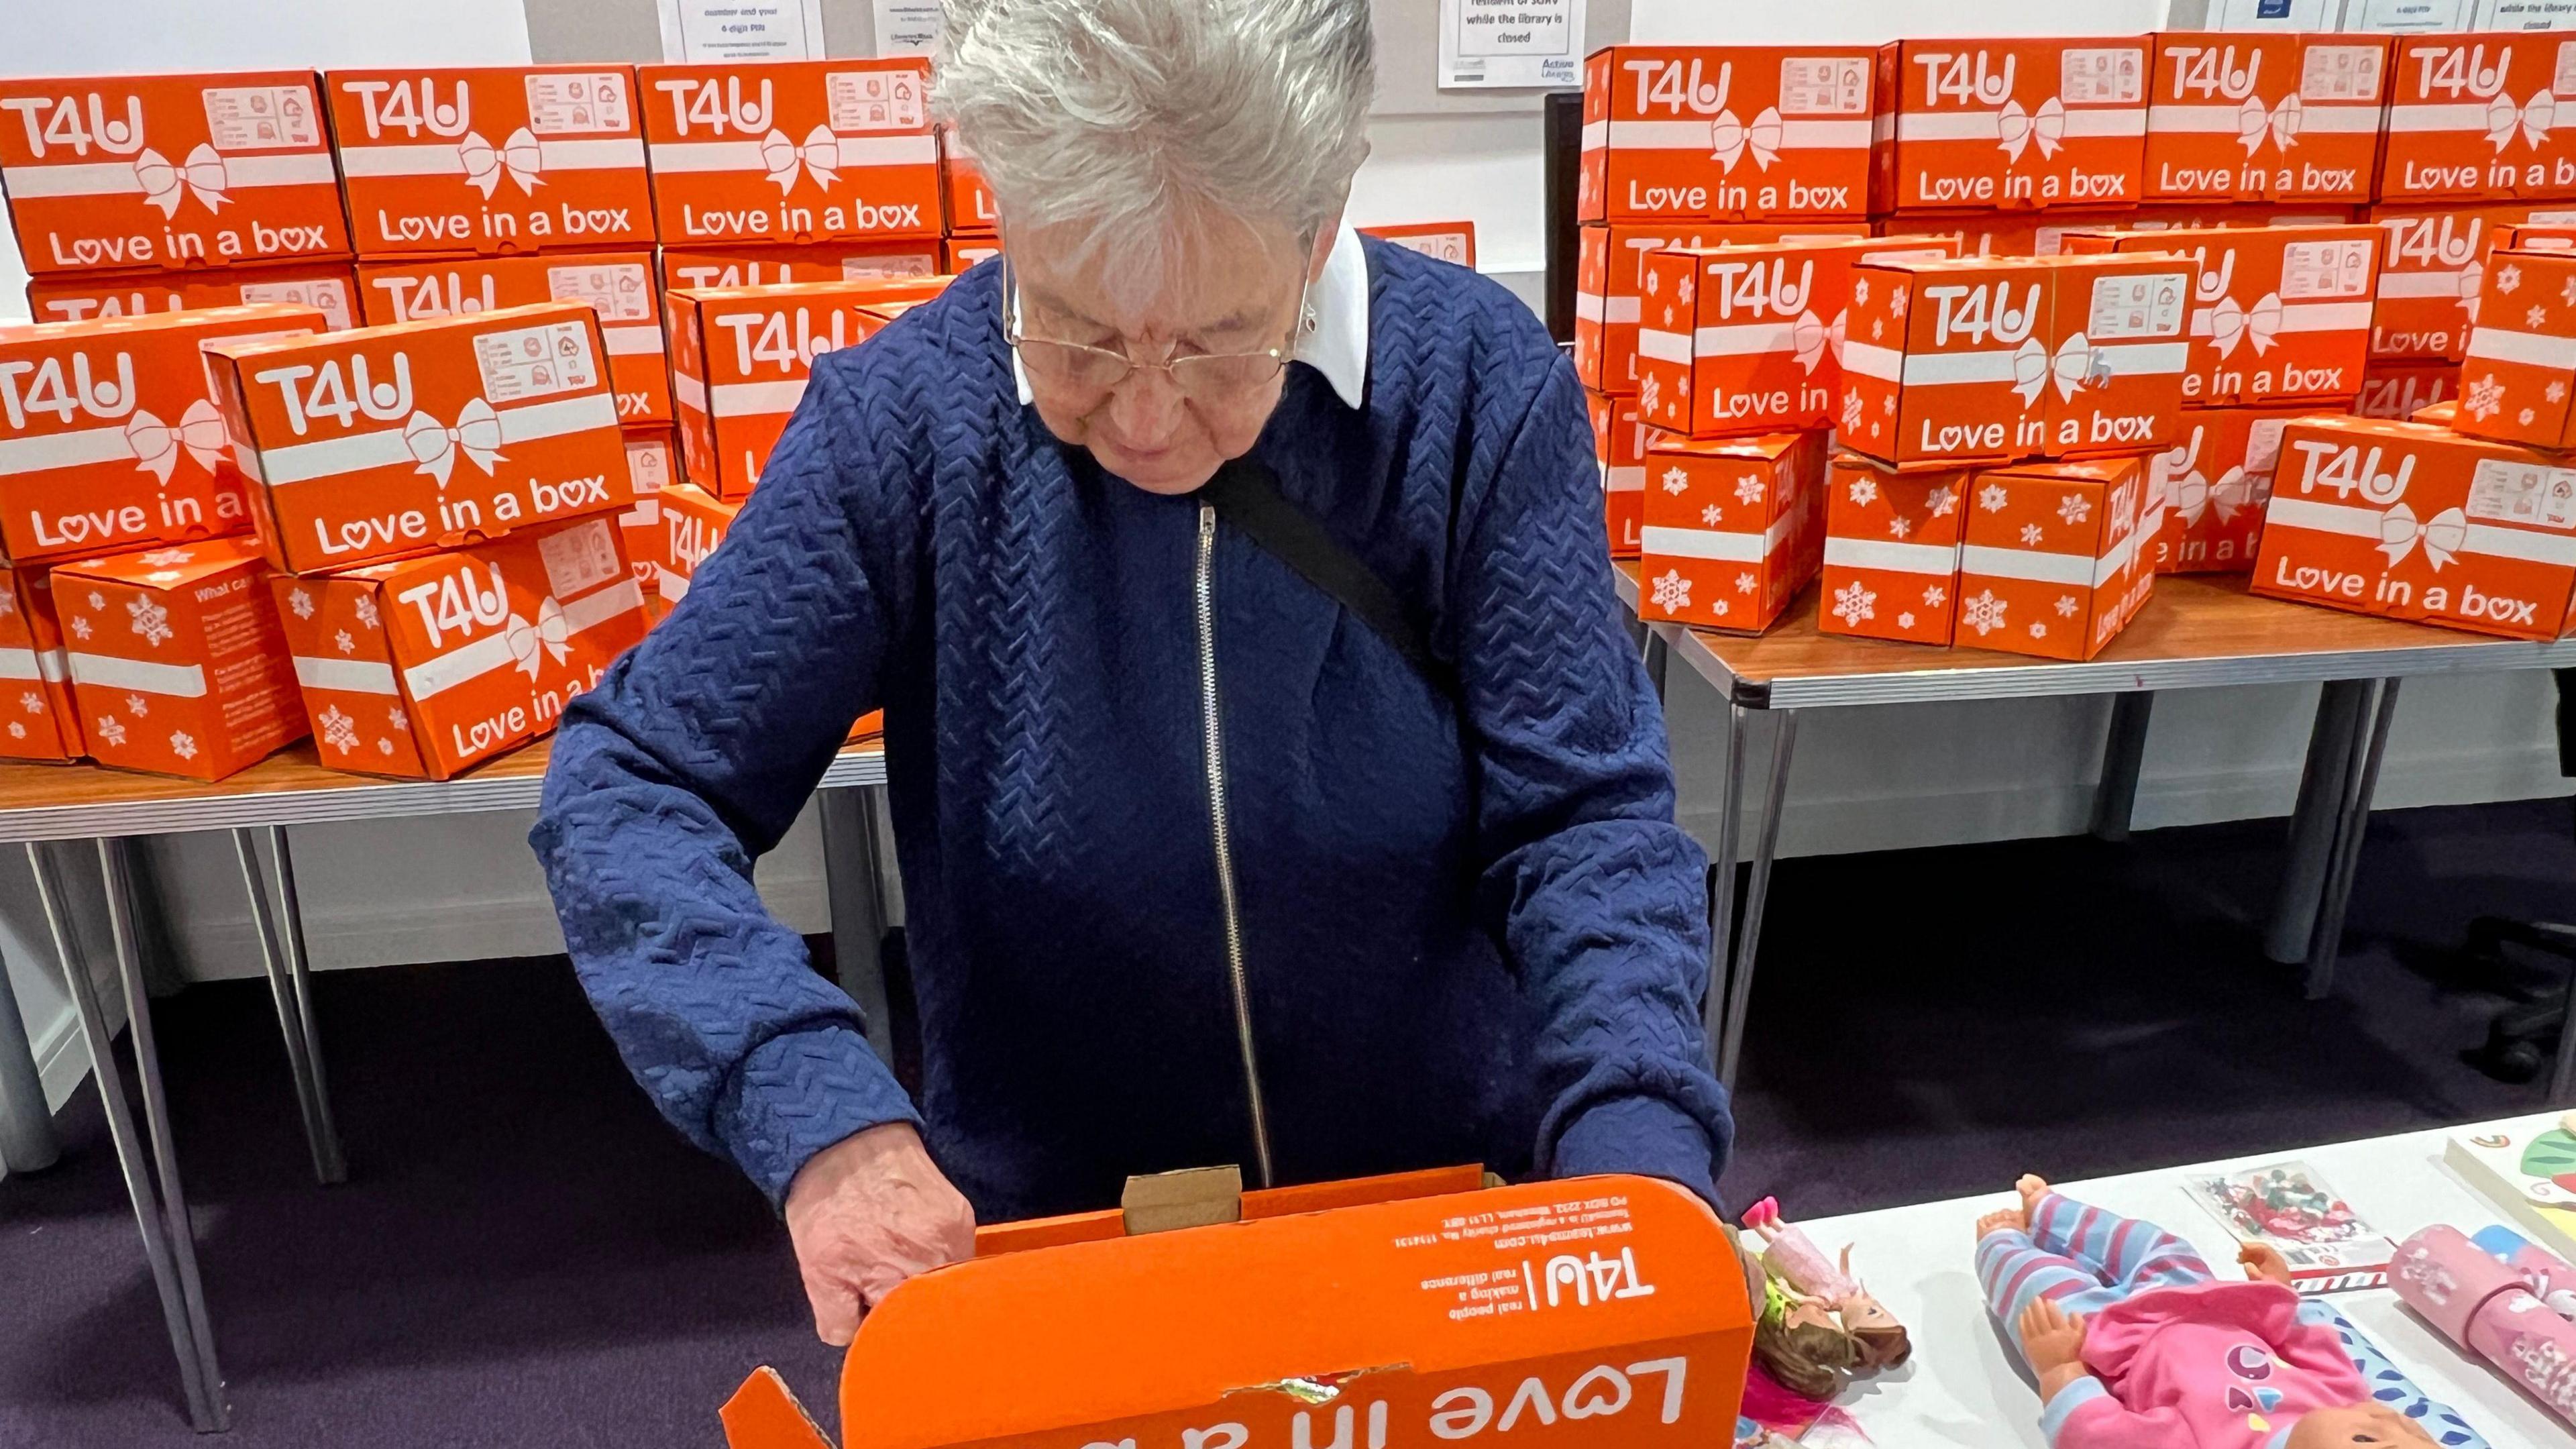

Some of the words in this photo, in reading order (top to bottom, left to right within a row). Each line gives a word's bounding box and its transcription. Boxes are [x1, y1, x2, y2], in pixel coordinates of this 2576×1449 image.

[1466, 13, 1495, 25] while
[1498, 14, 1515, 24] the
[1518, 13, 1552, 25] library
[1554, 13, 1562, 24] is
[1497, 32, 1531, 44] closed
[1623, 58, 1732, 115] T4U
[1913, 50, 2015, 106] T4U
[2164, 45, 2262, 99] T4U
[2410, 43, 2512, 99] T4U
[1, 93, 144, 158] T4U
[342, 78, 470, 139] T4U
[655, 75, 773, 136] T4U
[1629, 180, 1707, 210] Love
[1718, 179, 1746, 209] in
[1758, 186, 1776, 209] a
[1789, 178, 1849, 209] box
[1919, 170, 1993, 201] Love
[2004, 168, 2032, 199] in
[2041, 174, 2060, 197] a
[2070, 167, 2125, 196] box
[2159, 162, 2231, 192] Love
[2239, 162, 2265, 191] in
[2275, 168, 2294, 191] a
[2302, 162, 2356, 191] box
[2404, 160, 2478, 190] Love
[2487, 158, 2516, 189] in
[2525, 163, 2545, 186] a
[378, 209, 470, 241] Love
[481, 206, 517, 237] in
[529, 211, 551, 235] a
[562, 203, 631, 233] box
[683, 204, 769, 235] Love
[780, 201, 812, 232] in
[824, 206, 845, 230] a
[856, 199, 921, 229] box
[2379, 215, 2481, 268] T4U
[49, 231, 153, 266] Love
[165, 225, 203, 259] in
[217, 231, 242, 256] a
[253, 221, 328, 252] box
[1708, 258, 1814, 319] T4U
[1925, 280, 2041, 346] T4U
[716, 307, 845, 376] T4U
[2373, 326, 2449, 354] Love
[0, 352, 136, 429] T4U
[255, 352, 413, 435] T4U
[617, 392, 651, 415] ox
[1713, 387, 1789, 419] Love
[1801, 382, 1828, 413] in
[2212, 366, 2242, 395] in
[2251, 370, 2271, 394] a
[2282, 362, 2343, 392] box
[1921, 417, 2004, 452] Love
[2016, 414, 2045, 447] in
[2059, 419, 2079, 443] a
[2091, 409, 2155, 443] box
[2294, 439, 2416, 504] T4U
[31, 504, 148, 547] Love
[157, 492, 201, 527] in
[215, 491, 243, 520] a
[315, 507, 426, 555] Love
[437, 494, 481, 531] in
[493, 491, 521, 519] a
[529, 474, 609, 513] box
[398, 561, 508, 649] T4U
[2276, 556, 2365, 596] Love
[2375, 572, 2411, 606] in
[2423, 587, 2447, 611] a
[2460, 585, 2538, 626] box
[452, 706, 526, 758] Love
[531, 689, 562, 722] in
[1420, 1271, 1487, 1289] difference
[1458, 1291, 1466, 1301] a
[1470, 1285, 1519, 1301] making
[1491, 1268, 1517, 1282] real
[1546, 1246, 1655, 1307] T4U
[1448, 1304, 1495, 1321] people
[1499, 1301, 1523, 1315] real
[1429, 1356, 1687, 1440] Love
[1292, 1399, 1388, 1449] in
